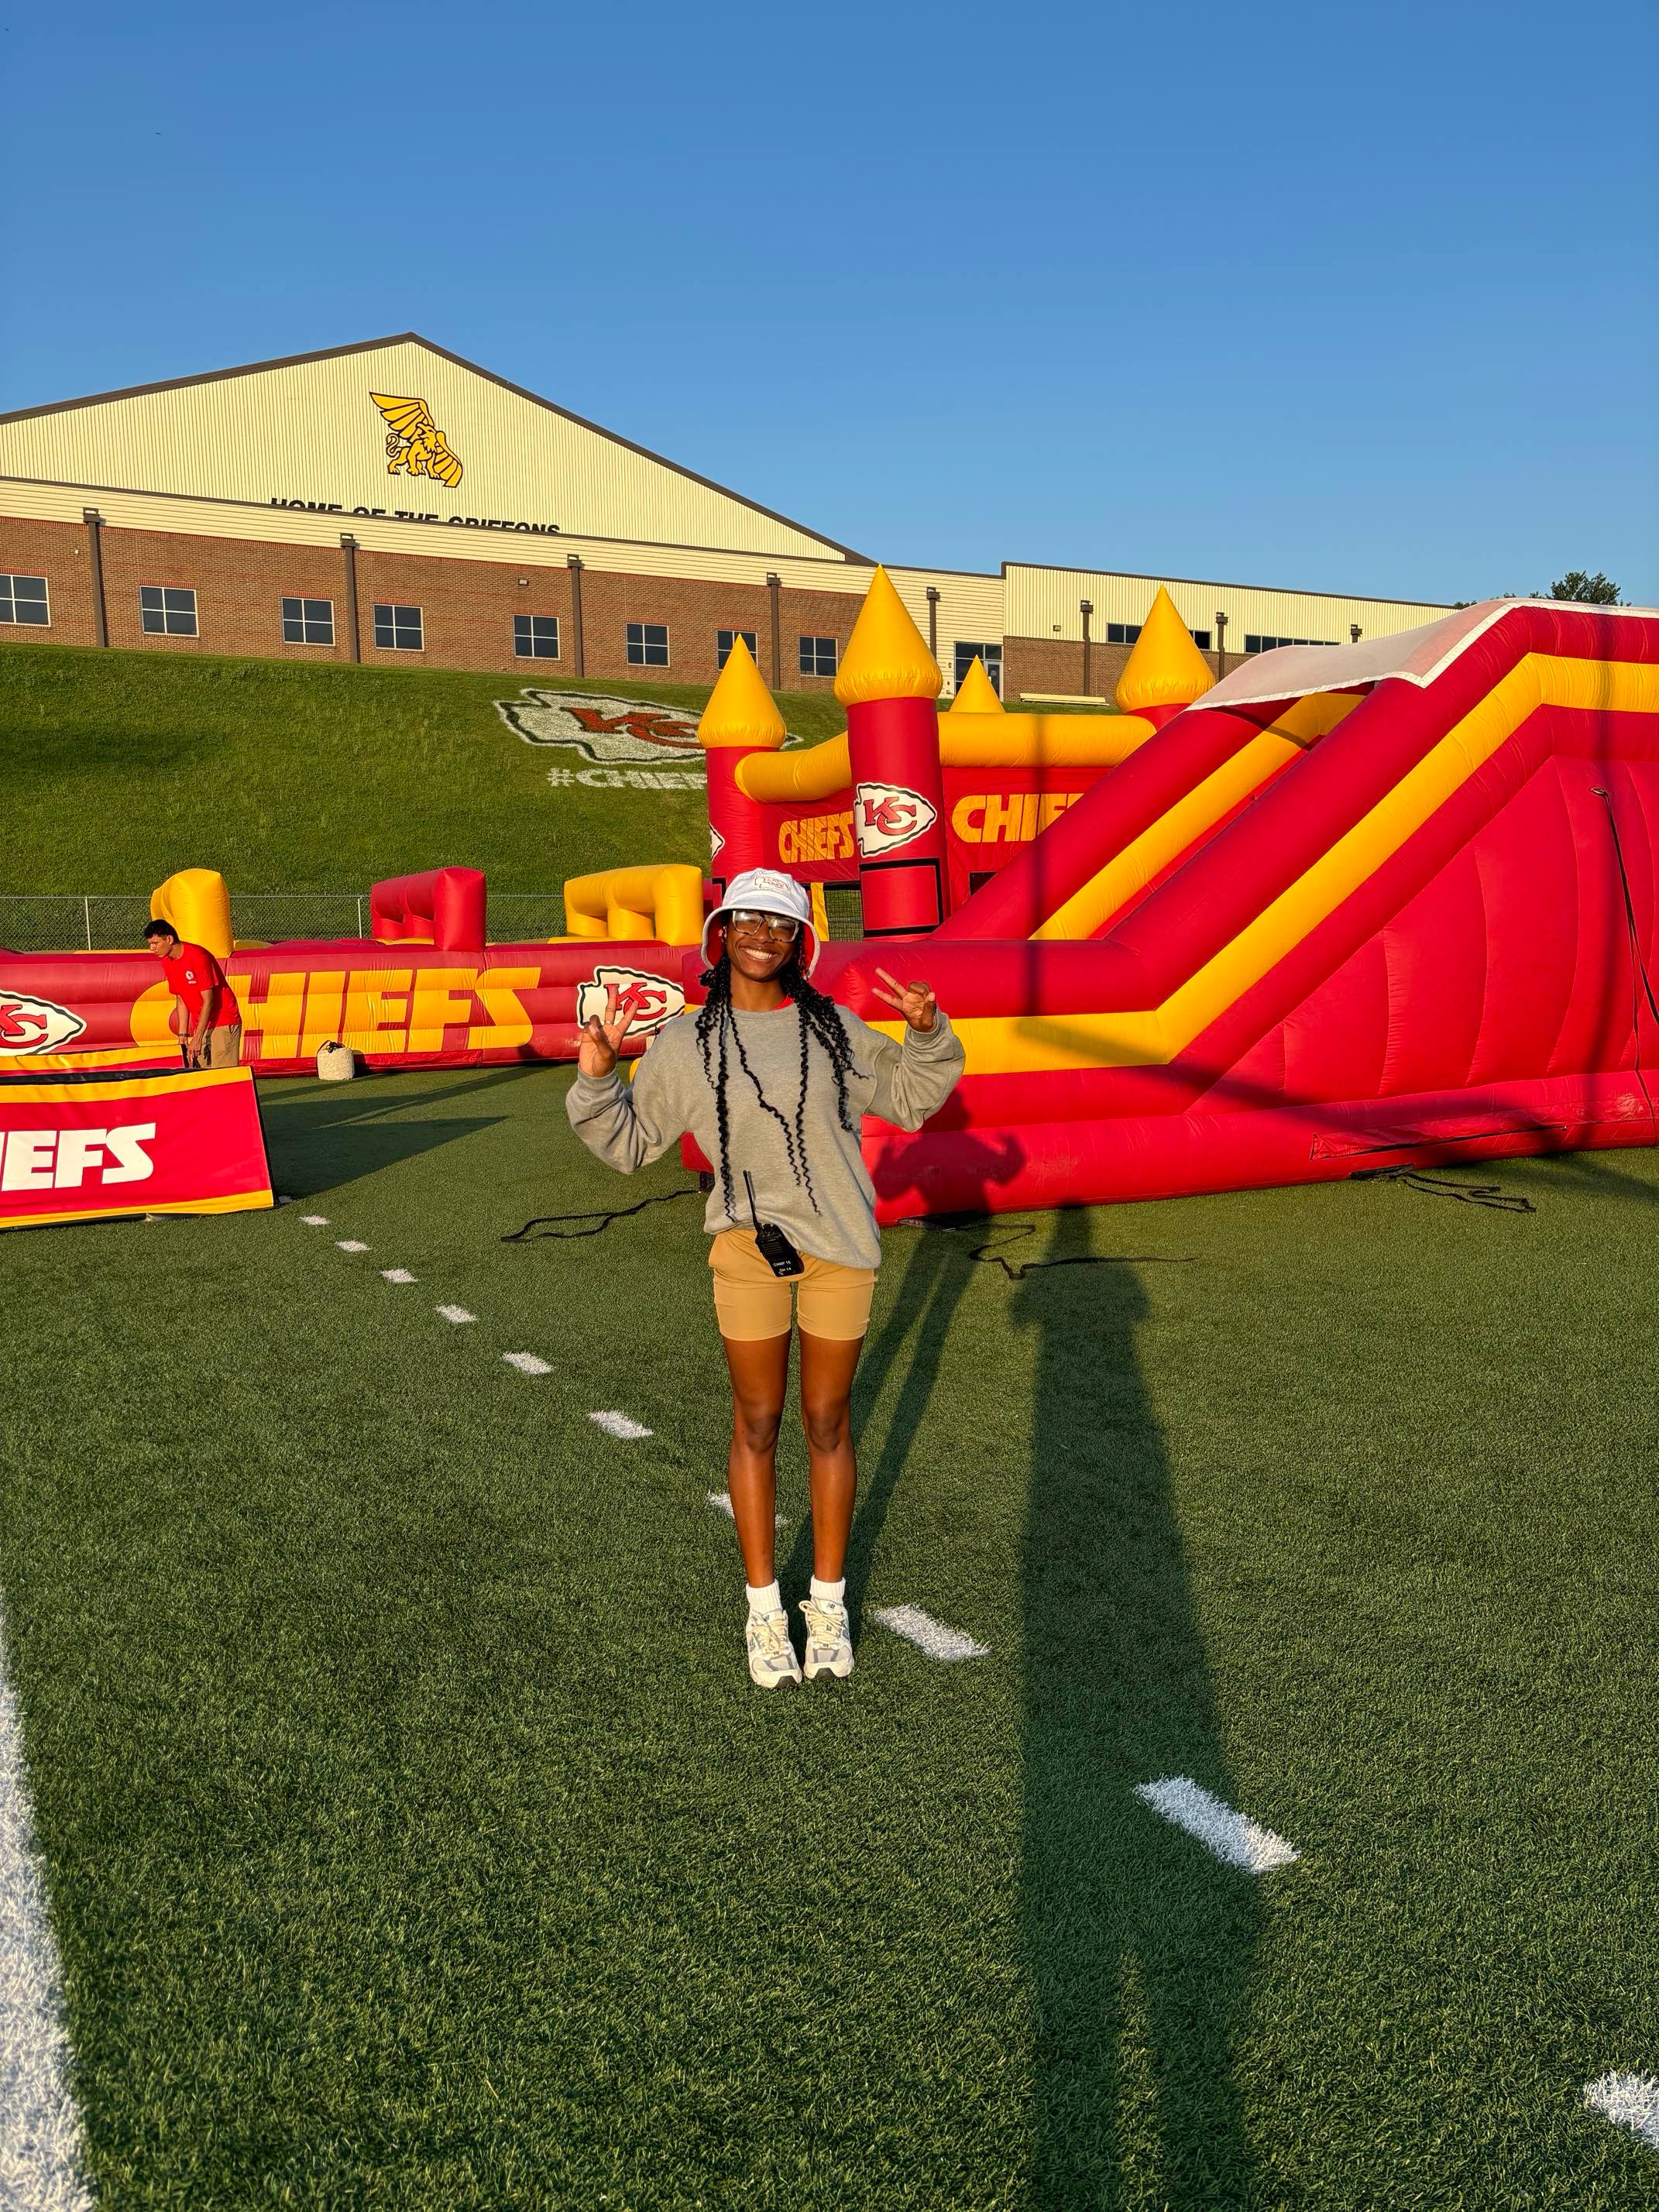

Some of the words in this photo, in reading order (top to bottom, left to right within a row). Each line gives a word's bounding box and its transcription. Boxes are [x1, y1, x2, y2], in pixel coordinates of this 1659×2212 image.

[778, 811, 854, 864] CHIEFS
[863, 796, 918, 836] KC
[951, 793, 1084, 843] CHIE
[604, 982, 667, 1021] KC
[0, 1122, 156, 1191] EFS
